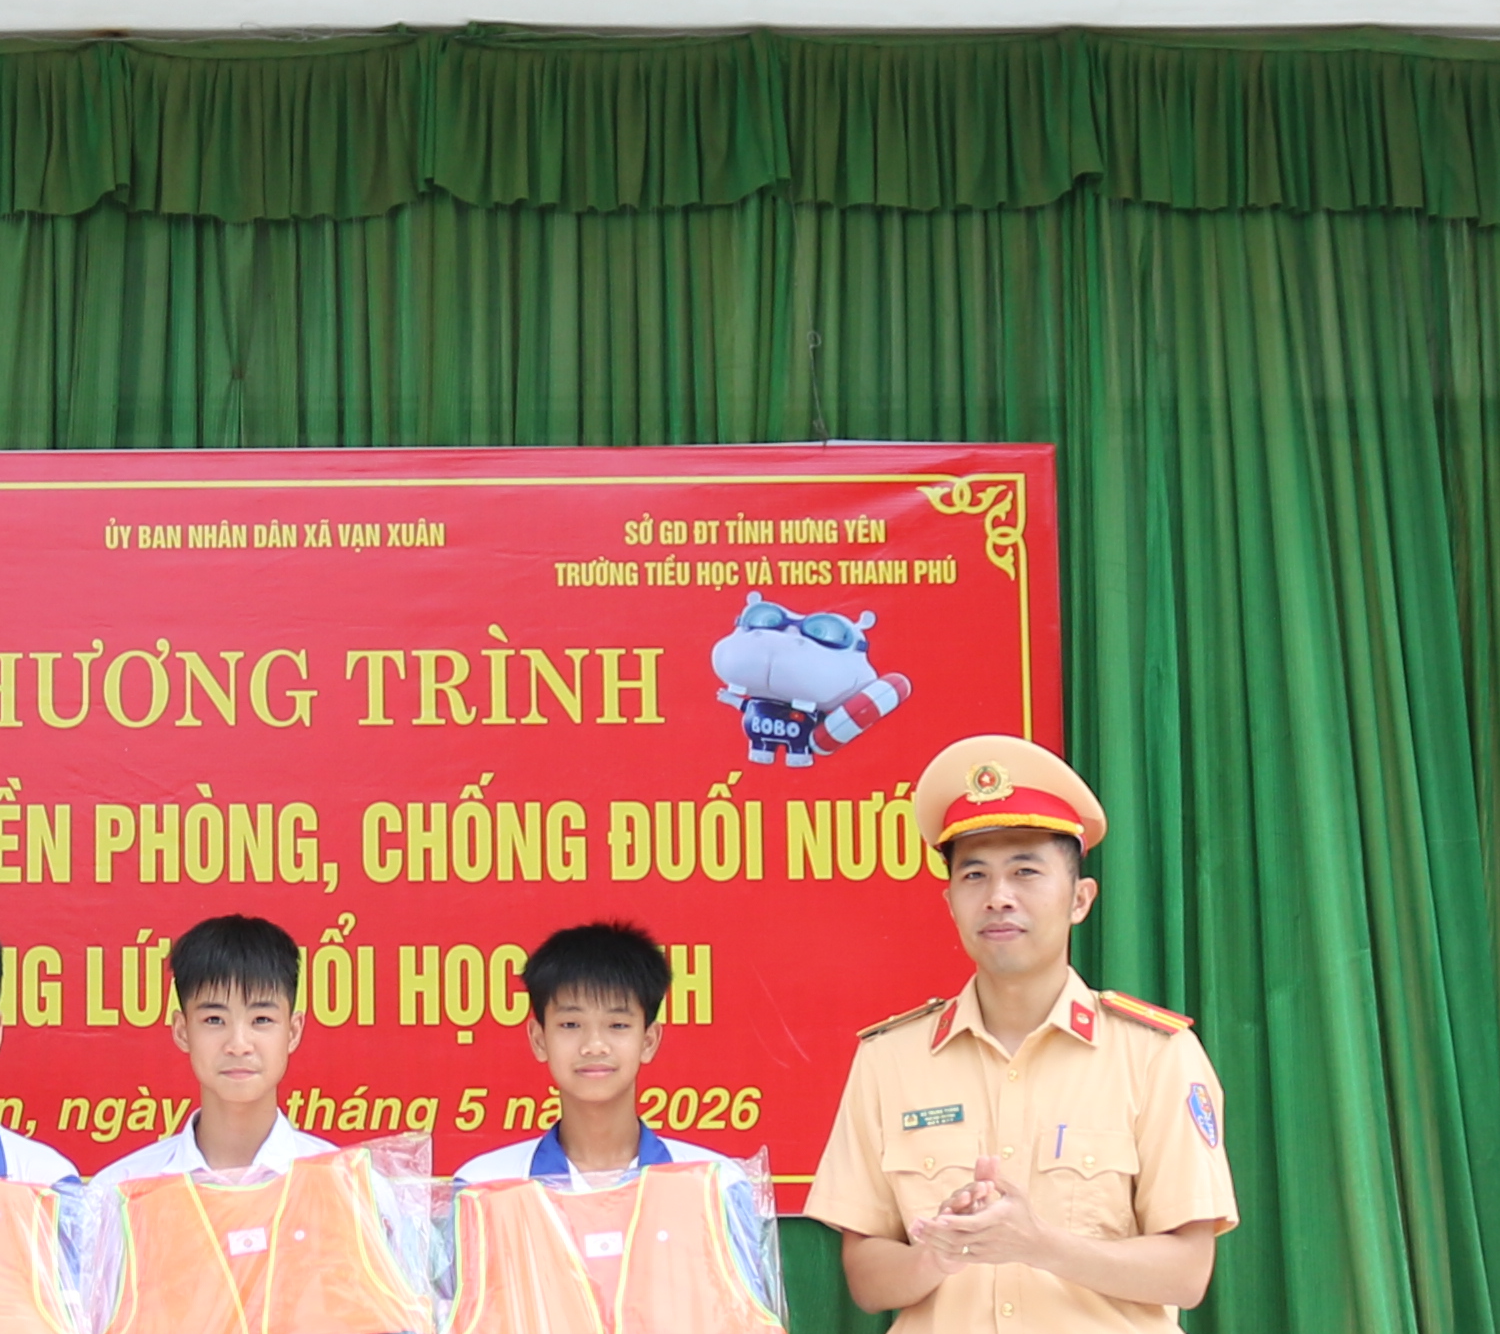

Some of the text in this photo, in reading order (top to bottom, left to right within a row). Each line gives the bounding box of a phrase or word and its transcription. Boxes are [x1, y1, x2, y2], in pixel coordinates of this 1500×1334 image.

[104, 518, 446, 554] ỦY BAN NHÂN DÂN XÃ VẠN XUÂN
[624, 513, 888, 546] SỞ GD ĐT TỈNH HƯNG YÊN
[554, 554, 958, 592] TRƯỜNG TIỂU HỌC VÀ THCS THANH PHÚ
[345, 623, 667, 727] TRÌNH
[751, 717, 800, 738] BOBO
[95, 783, 339, 893] PHÒNG,
[362, 772, 588, 884] CHỐNG
[607, 770, 764, 883] ĐUỐI
[786, 781, 950, 882] NƯỚ
[86, 928, 183, 1027] LỨ
[399, 944, 531, 1045] HỌC
[57, 1085, 192, 1144] ngày
[286, 1085, 439, 1141] tháng
[455, 1087, 488, 1132] 5
[502, 1085, 563, 1131] nă
[638, 1086, 763, 1132] 2026
